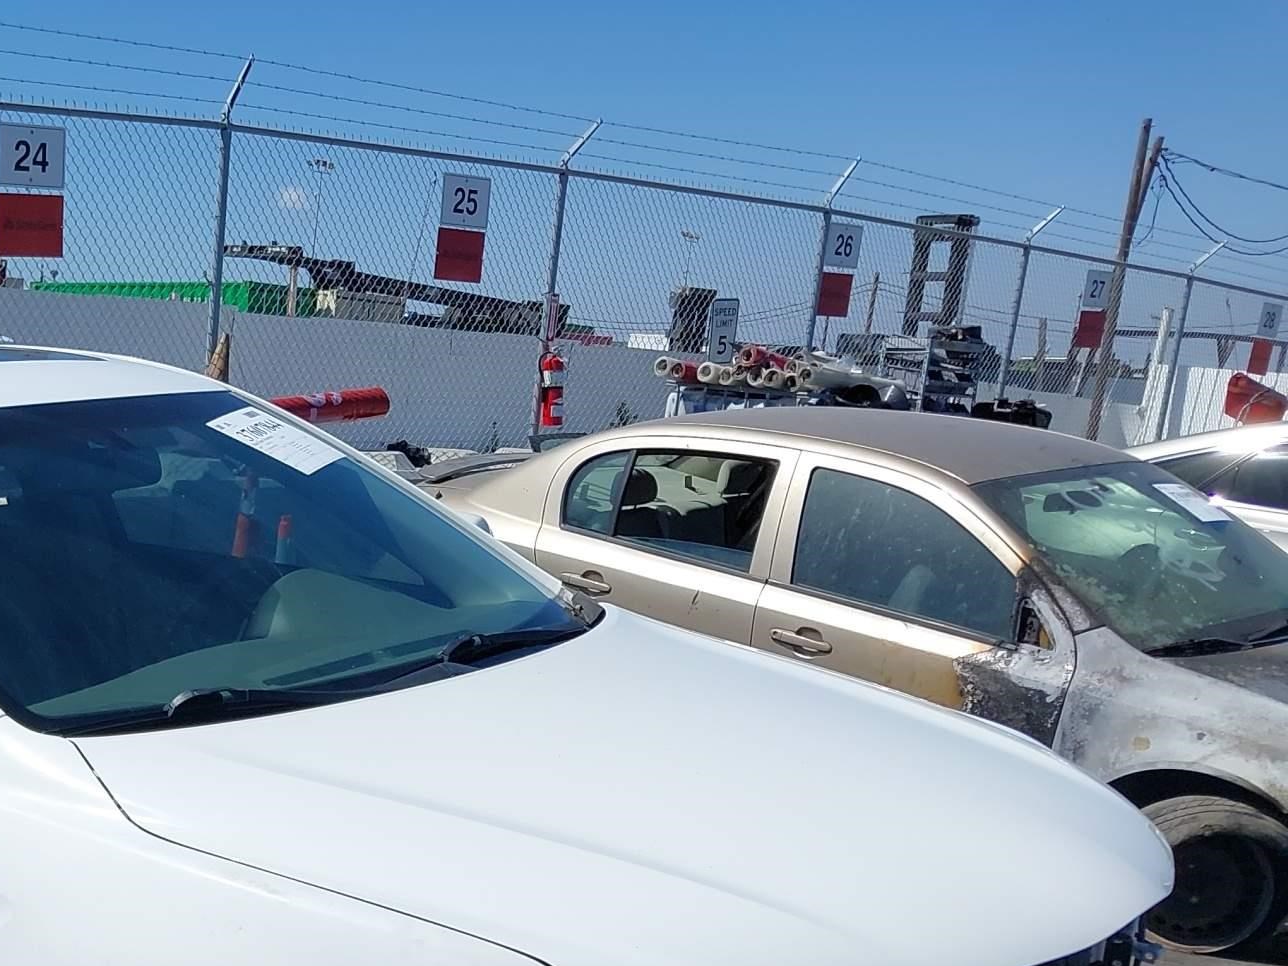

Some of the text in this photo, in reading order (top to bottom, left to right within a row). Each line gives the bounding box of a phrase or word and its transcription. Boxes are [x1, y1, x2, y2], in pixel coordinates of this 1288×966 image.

[14, 140, 49, 173] 24
[453, 187, 478, 215] 25
[835, 234, 854, 257] 26
[1090, 280, 1105, 298] 27
[714, 307, 736, 317] SPEED
[1263, 312, 1276, 329] 28
[715, 319, 733, 328] LIMIT
[717, 335, 727, 355] 5
